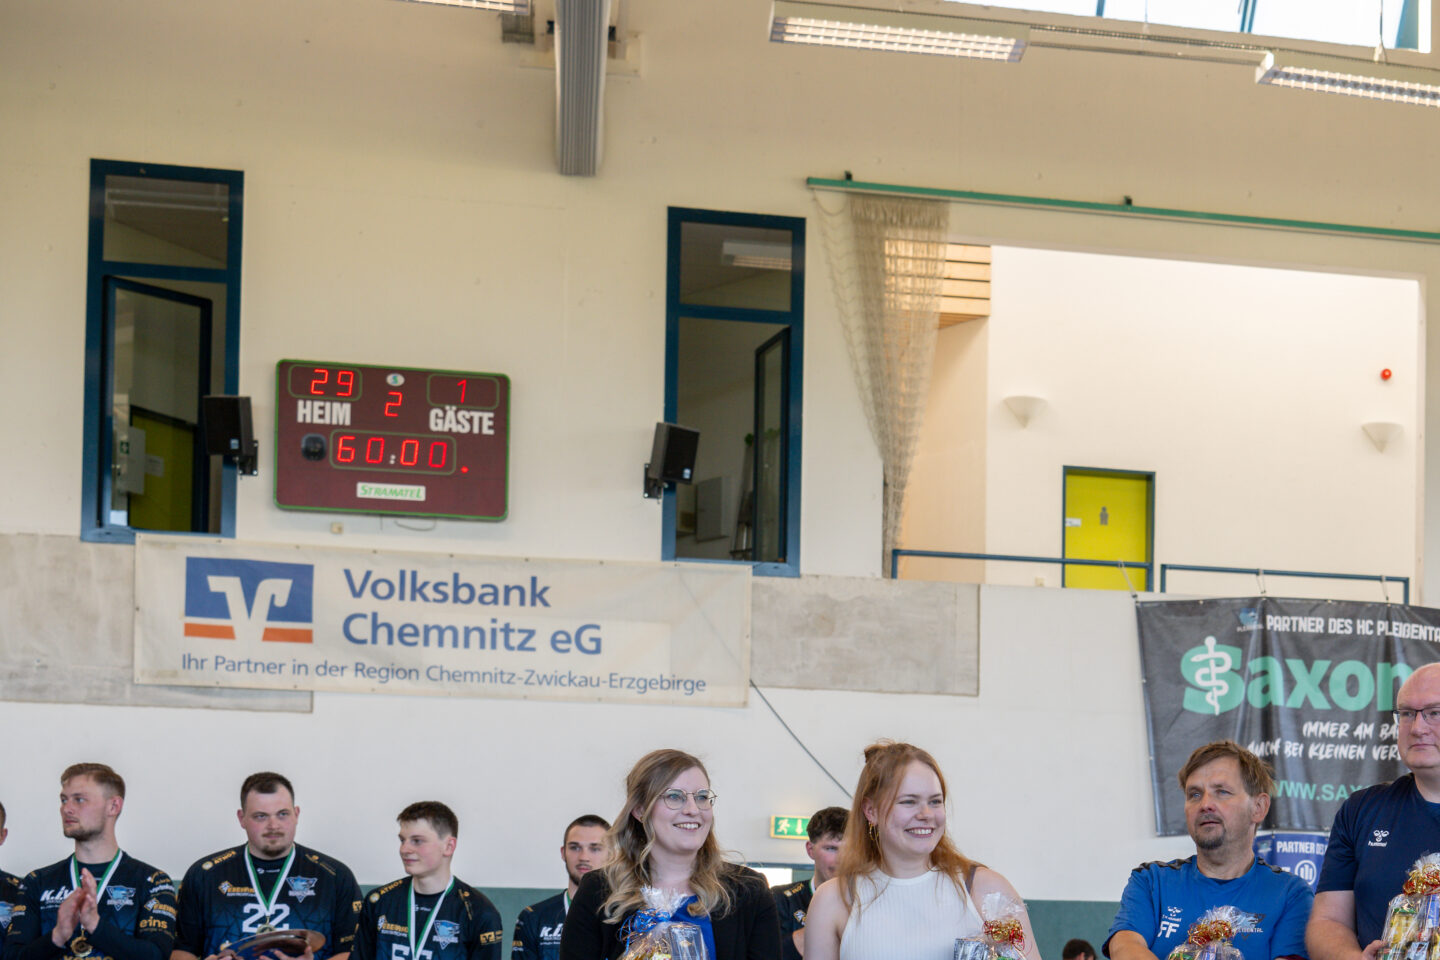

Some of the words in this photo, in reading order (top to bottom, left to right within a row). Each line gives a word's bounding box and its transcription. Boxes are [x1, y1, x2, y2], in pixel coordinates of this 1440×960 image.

[311, 368, 354, 396] 29
[456, 379, 467, 403] 1
[297, 399, 351, 426] HEIM
[384, 391, 403, 417] 2
[429, 405, 495, 435] GÄSTE
[360, 484, 423, 499] STRAMATEL
[343, 568, 552, 608] Volksbank
[342, 611, 537, 653] Chemnitz
[549, 623, 602, 655] eG
[1266, 614, 1324, 633] PARTNER
[1328, 620, 1353, 635] DES
[1356, 620, 1374, 635] HC
[182, 653, 208, 671] Ihr
[214, 655, 286, 676] Partner
[292, 659, 309, 676] in
[315, 660, 348, 677] der
[354, 662, 420, 683] Region
[425, 665, 706, 695] Chemnitz-Zwickau-Erzgebirge
[1302, 721, 1350, 739] IMMER
[1353, 722, 1374, 740] AM
[1284, 741, 1304, 760] BEI
[1308, 741, 1367, 760] KLEINEN
[1276, 841, 1316, 853] PARTNER
[242, 903, 290, 933] 22
